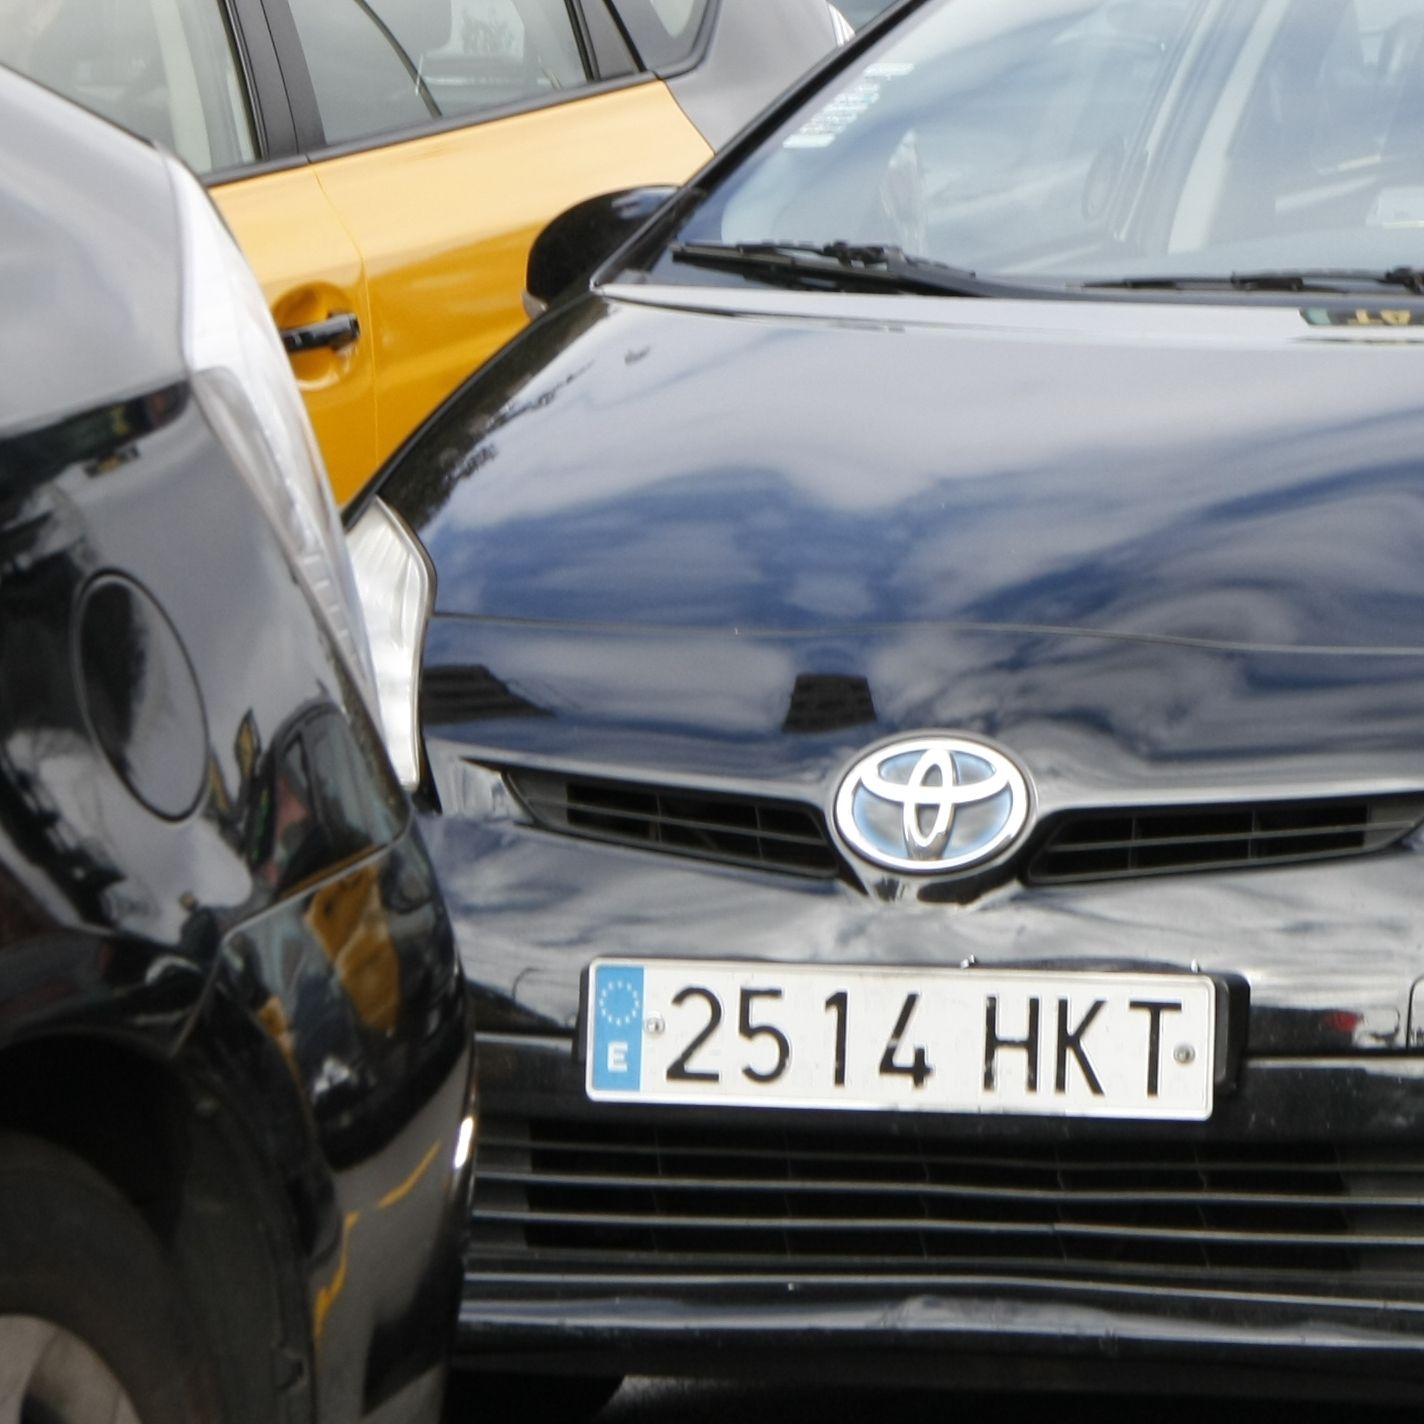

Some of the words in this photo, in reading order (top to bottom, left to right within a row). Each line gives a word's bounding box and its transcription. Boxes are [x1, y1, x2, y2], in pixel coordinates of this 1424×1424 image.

[607, 1042, 628, 1071] E
[665, 986, 934, 1089] 2514
[983, 996, 1182, 1097] HKT
